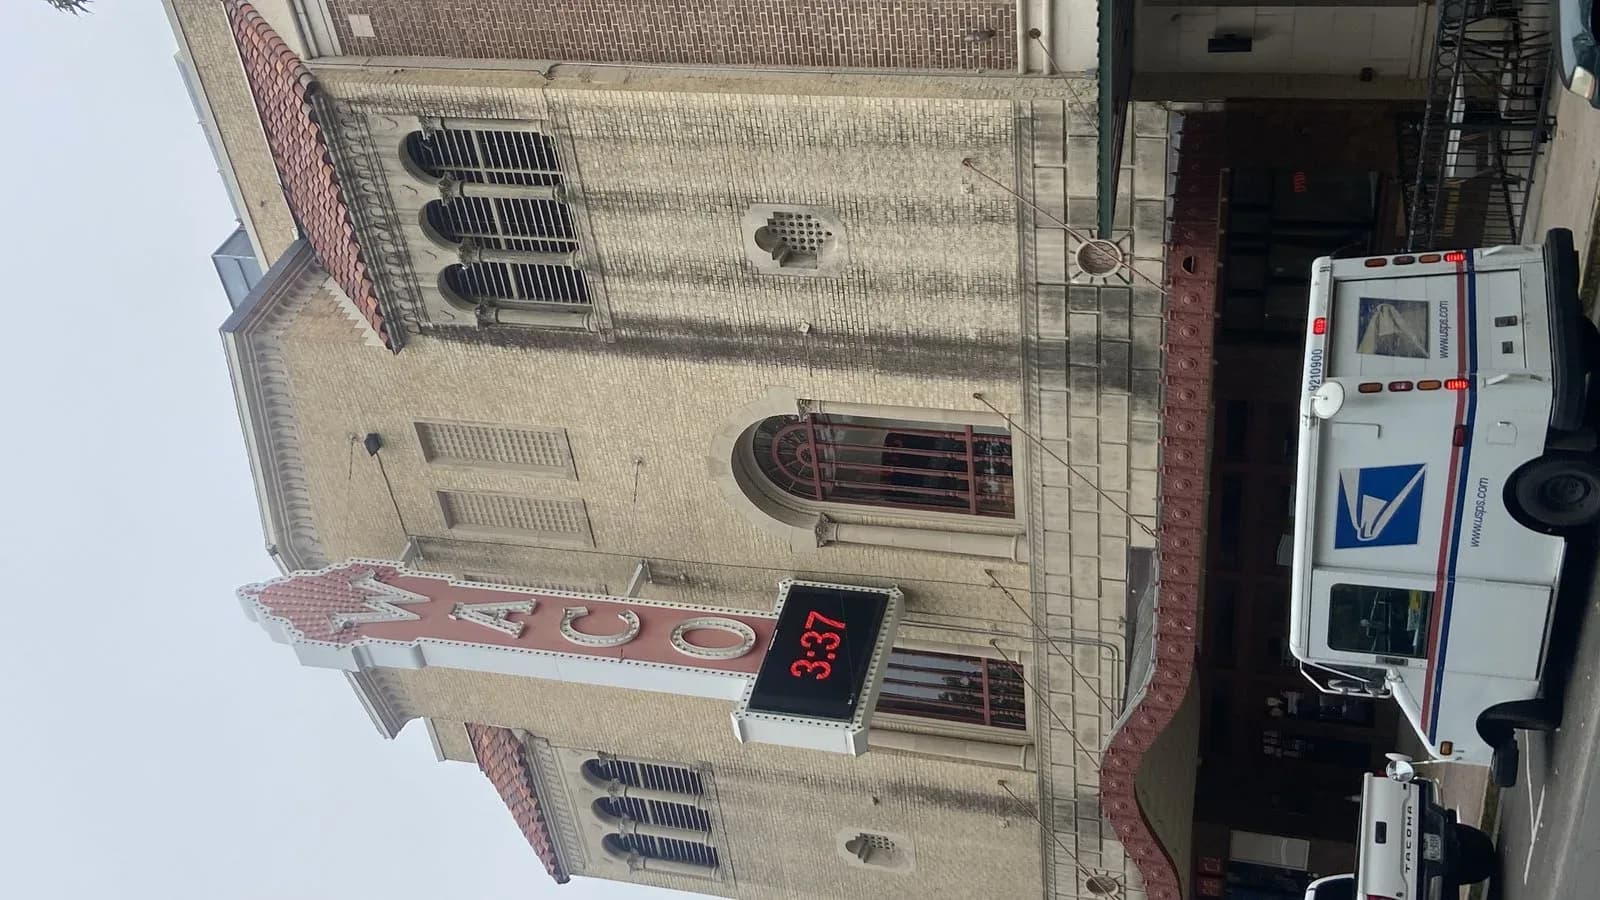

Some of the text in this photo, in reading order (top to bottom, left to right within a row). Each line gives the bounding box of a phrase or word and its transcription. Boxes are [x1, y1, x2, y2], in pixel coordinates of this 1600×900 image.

[1437, 300, 1450, 359] www.usps.com
[1307, 348, 1324, 392] 9210900
[1469, 477, 1490, 548] www.usps.com
[790, 609, 847, 680] 3:37
[1405, 805, 1413, 873] TACOMA
